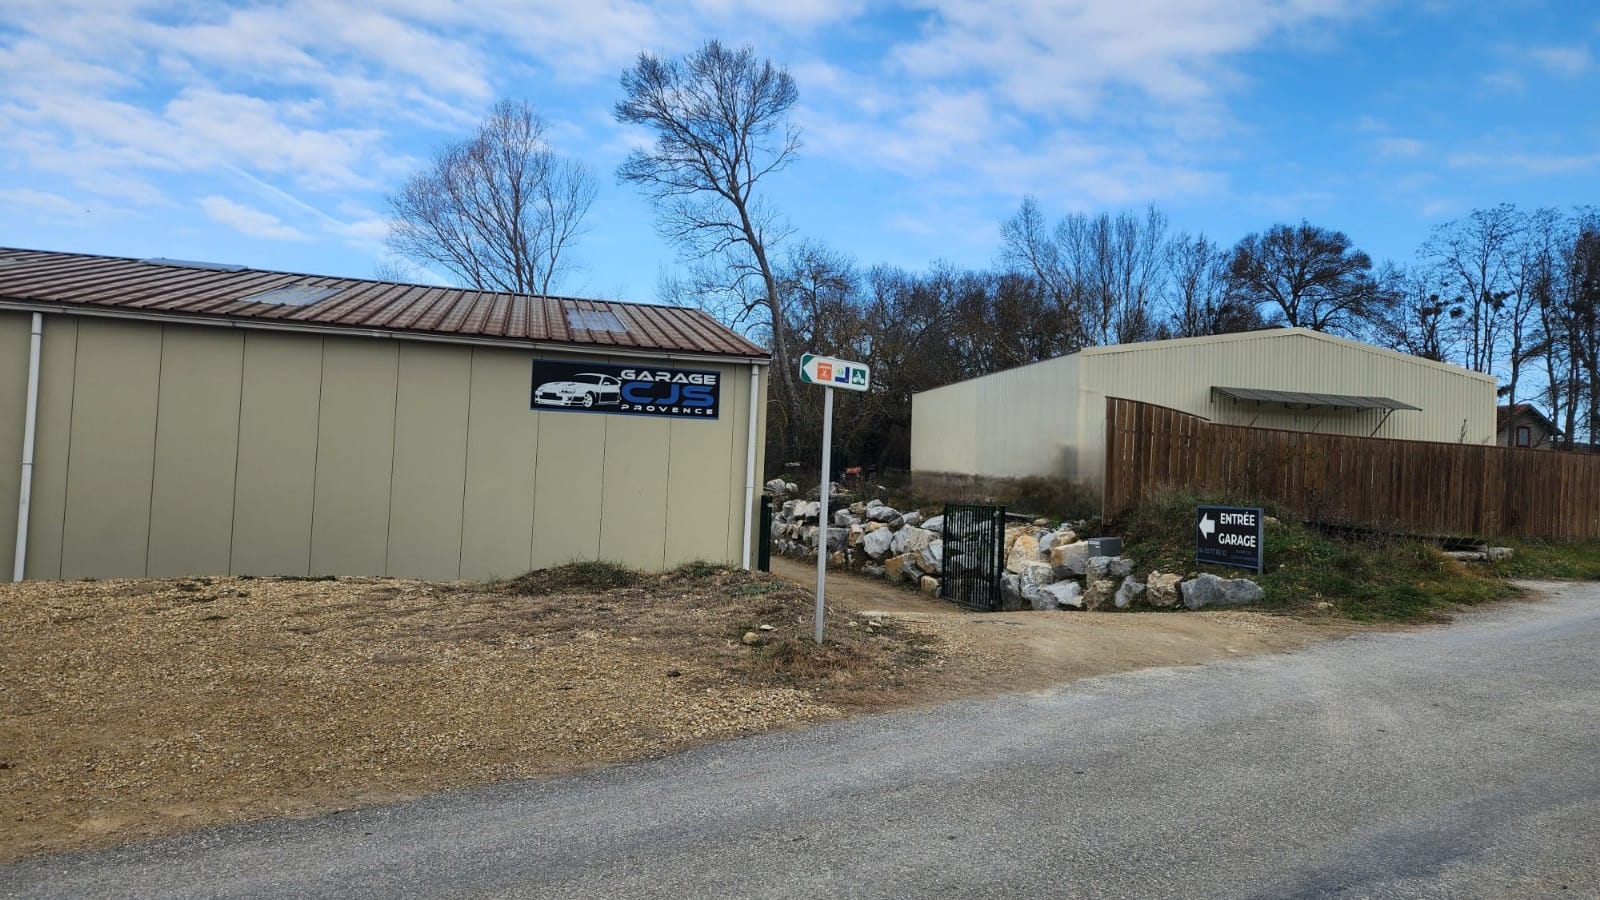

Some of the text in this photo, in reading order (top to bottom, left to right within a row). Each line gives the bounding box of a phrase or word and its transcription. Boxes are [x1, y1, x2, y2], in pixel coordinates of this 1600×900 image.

[620, 369, 717, 385] GARAGE
[621, 381, 715, 407] CJS
[620, 404, 713, 415] PROVENCE
[1220, 511, 1256, 526] ENTRÉE
[1218, 532, 1256, 548] GARAGE
